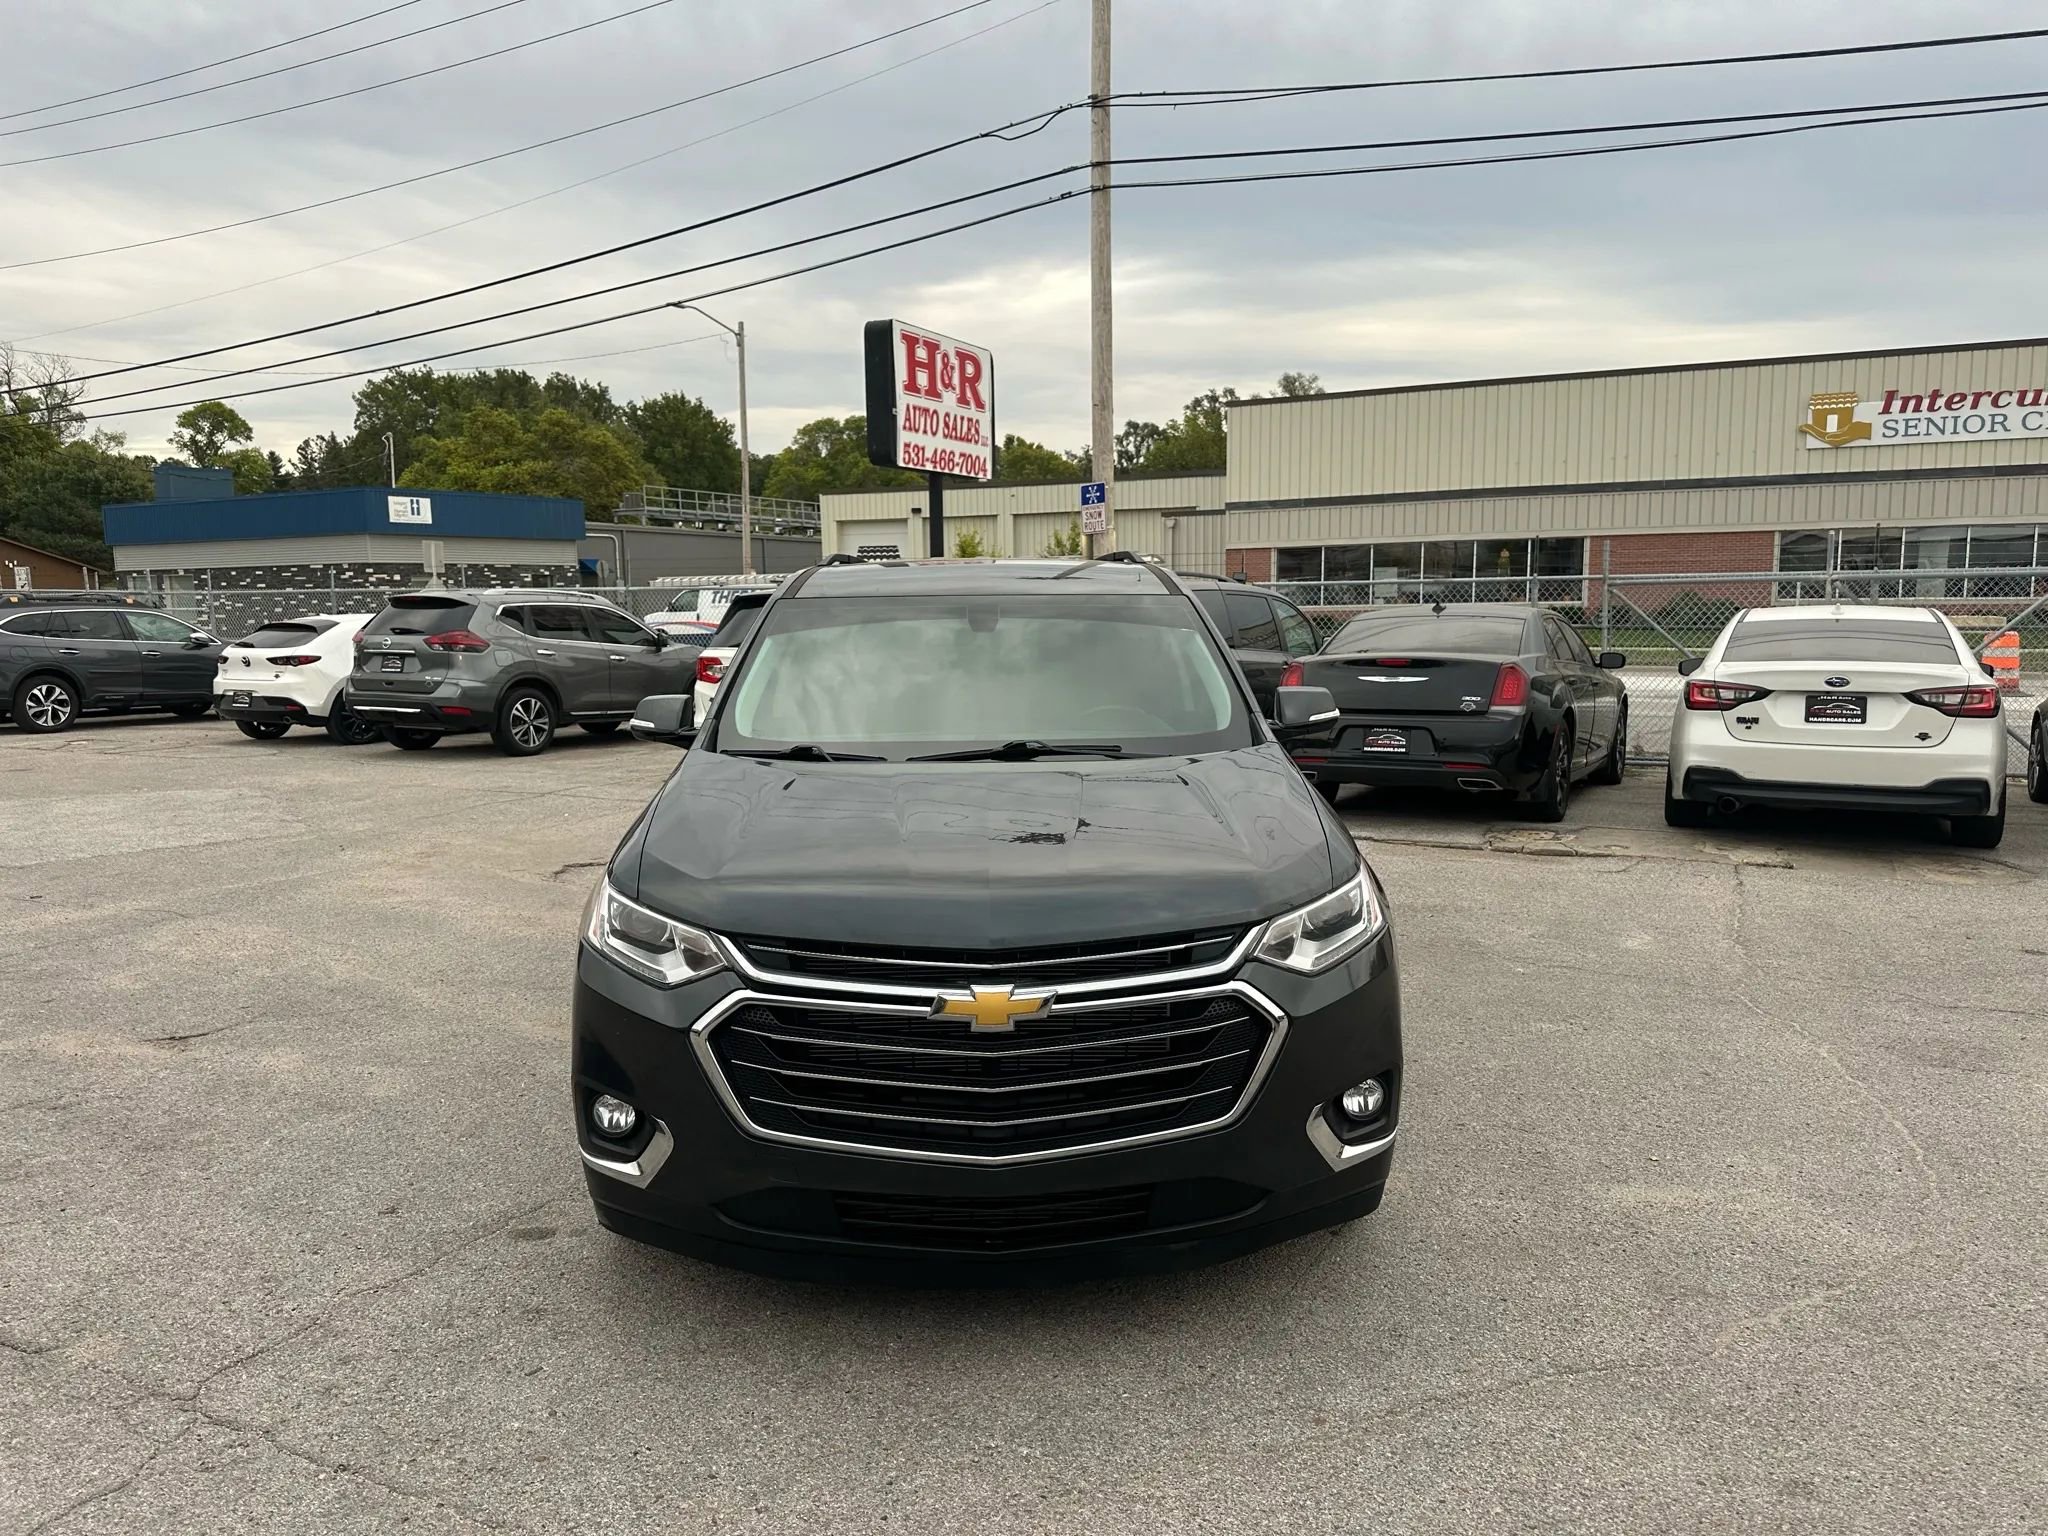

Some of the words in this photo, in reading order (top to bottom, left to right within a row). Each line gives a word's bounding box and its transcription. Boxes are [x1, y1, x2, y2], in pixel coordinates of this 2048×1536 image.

[901, 329, 986, 412] H&R
[1878, 388, 2048, 416] Intercu
[903, 403, 940, 436] AUTO
[942, 412, 980, 445] SALES
[1882, 413, 2012, 438] SENIOR
[2022, 411, 2048, 431] C
[903, 441, 988, 477] 531-466-7004
[1084, 510, 1102, 521] SNOW
[1084, 520, 1104, 531] ROUTE
